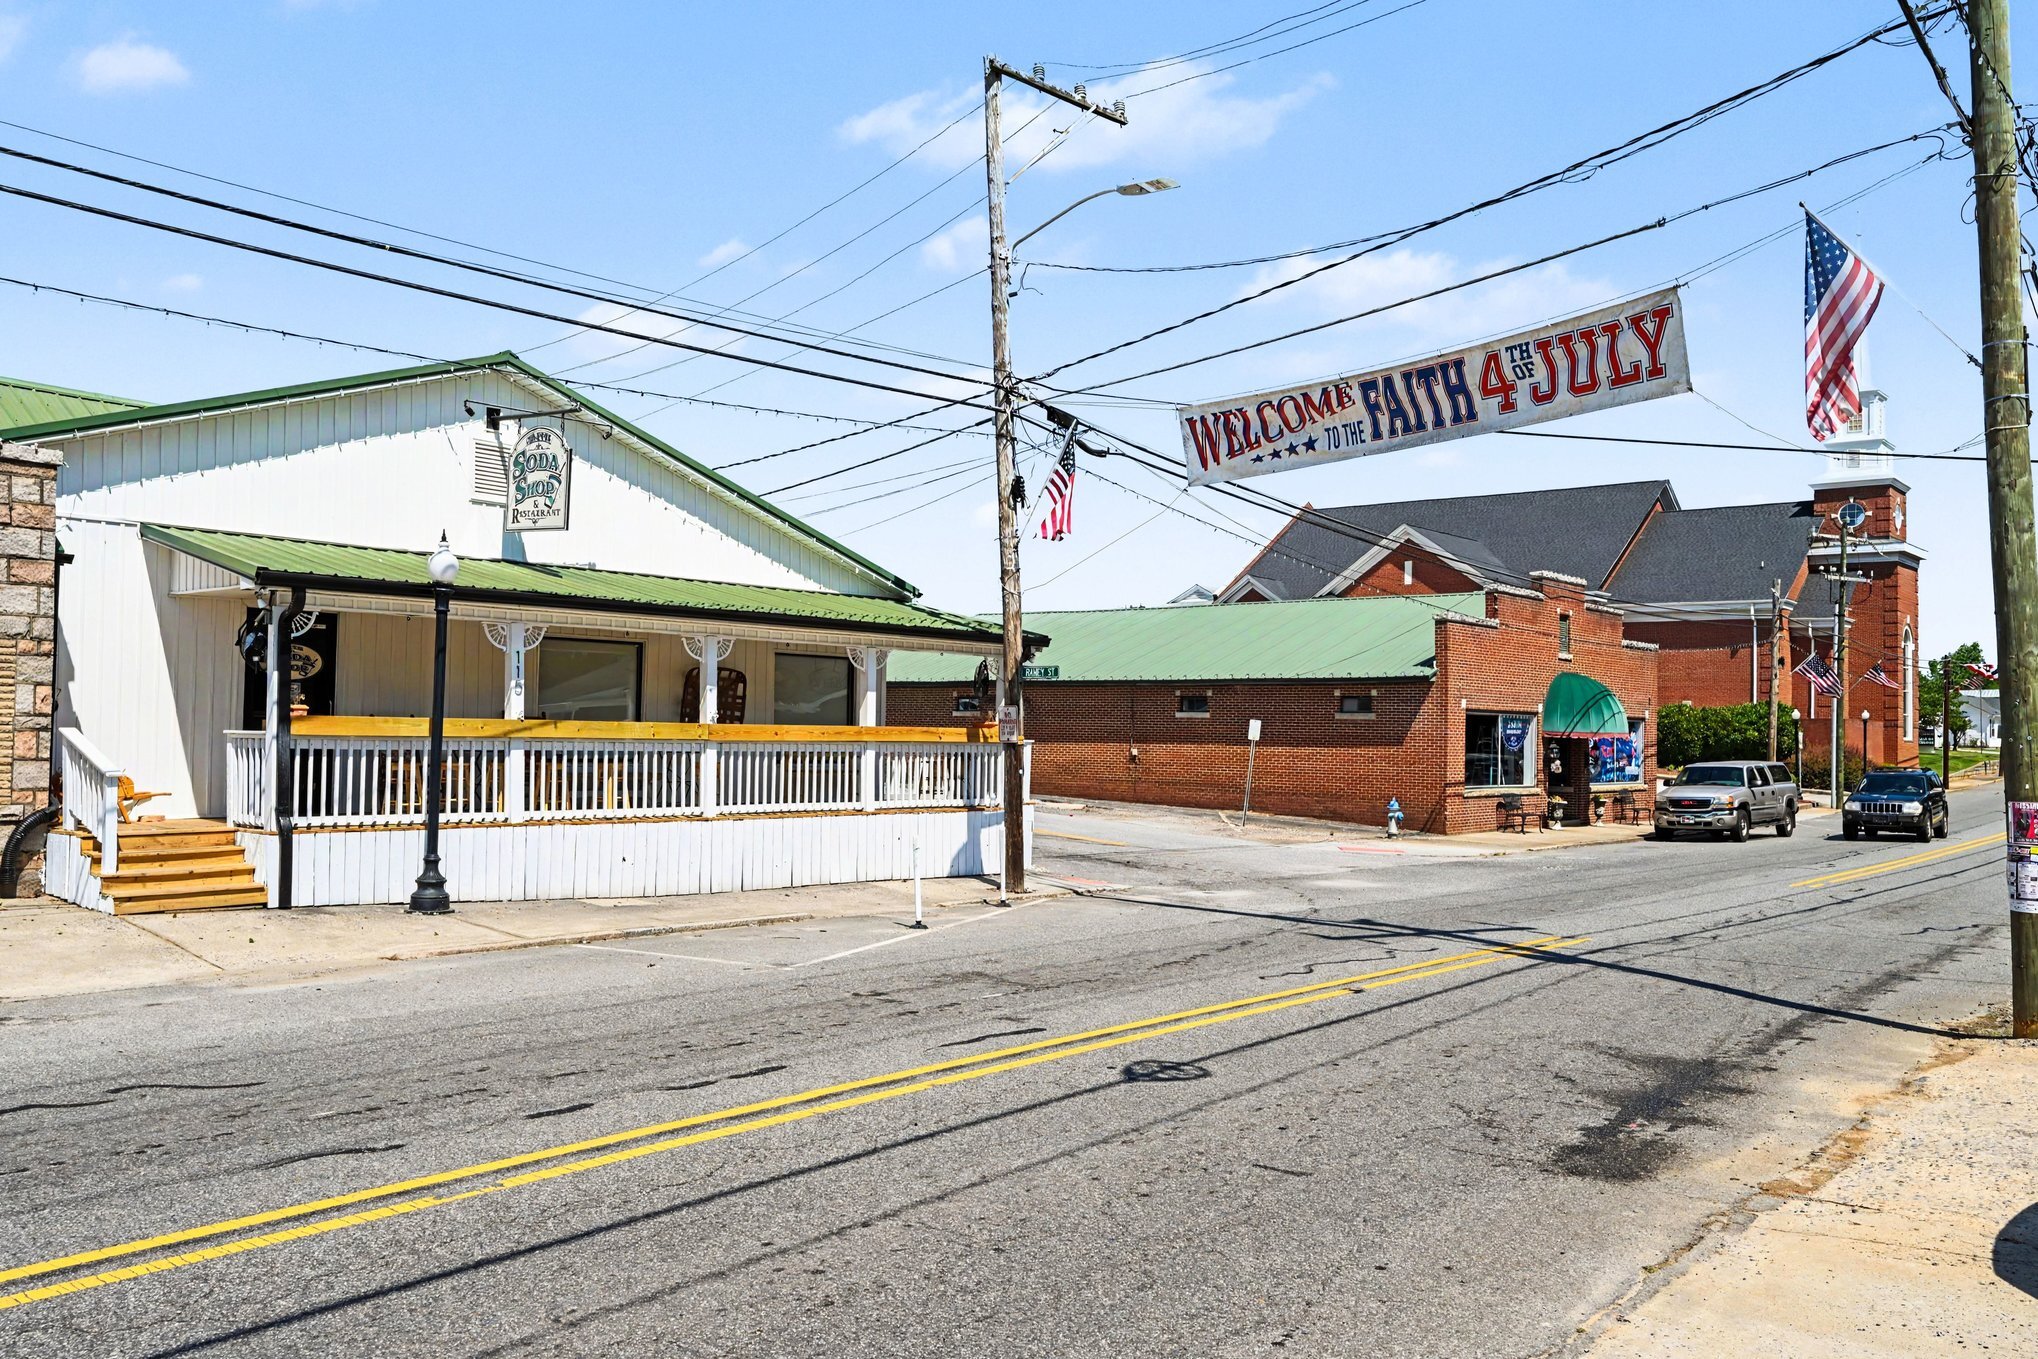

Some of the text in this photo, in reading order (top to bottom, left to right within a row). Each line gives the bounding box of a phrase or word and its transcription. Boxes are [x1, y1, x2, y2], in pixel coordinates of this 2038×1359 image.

[1358, 357, 1478, 441] FAITH
[1512, 361, 1535, 380] OF
[1529, 303, 1674, 406] JULY
[1185, 382, 1356, 471] WELCOME
[1324, 420, 1366, 450] TO THE
[513, 449, 559, 483] SODA
[514, 477, 556, 507] SHOP
[533, 499, 539, 508] &
[1047, 668, 1056, 677] ST
